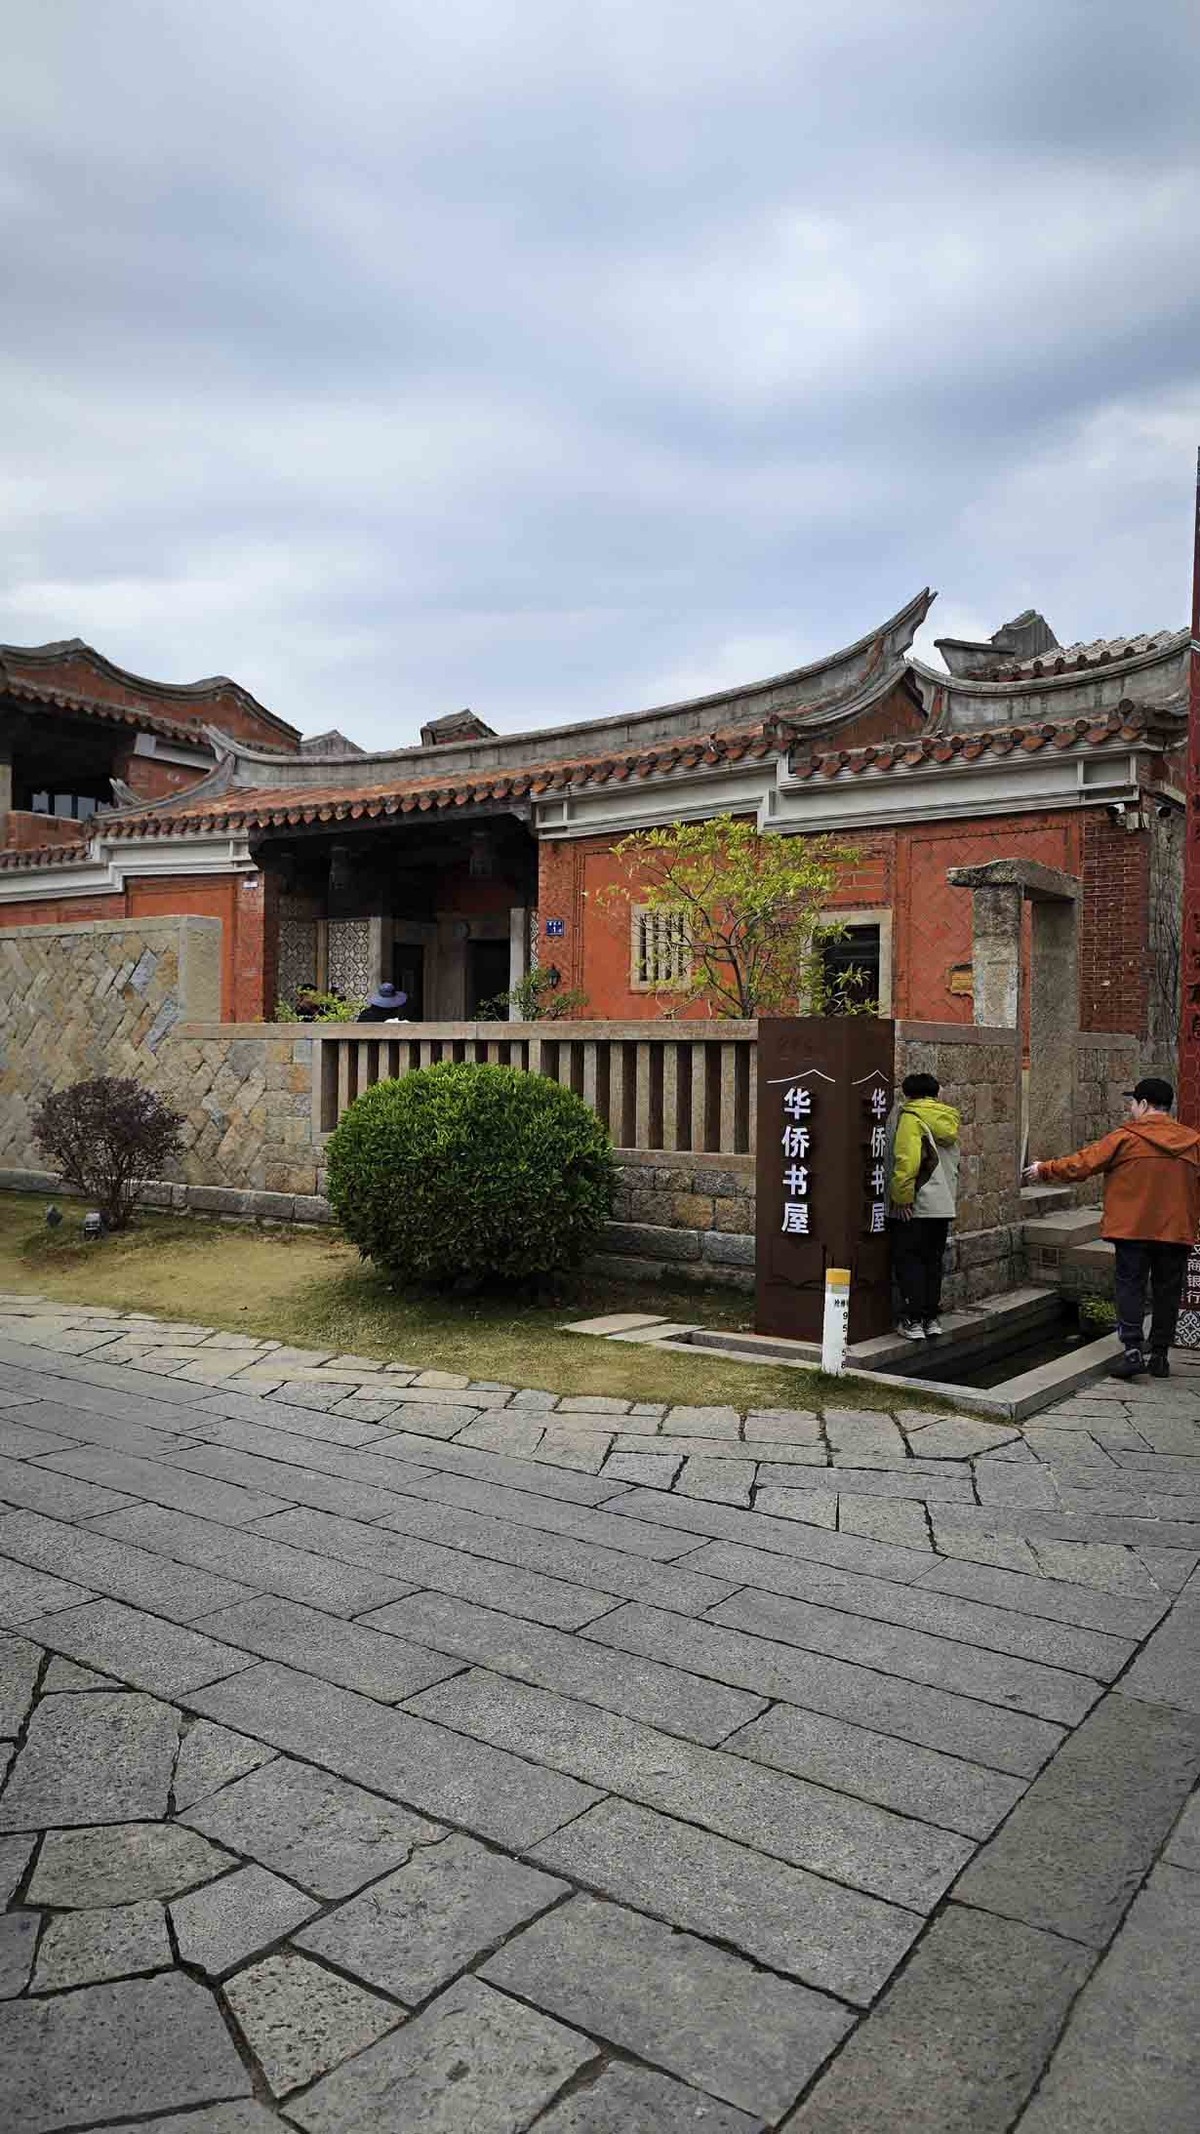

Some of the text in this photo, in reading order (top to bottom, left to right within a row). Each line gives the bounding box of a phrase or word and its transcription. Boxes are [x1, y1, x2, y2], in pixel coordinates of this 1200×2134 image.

[781, 1087, 812, 1235] 华侨书屋
[869, 1087, 887, 1234] 华侨书屋
